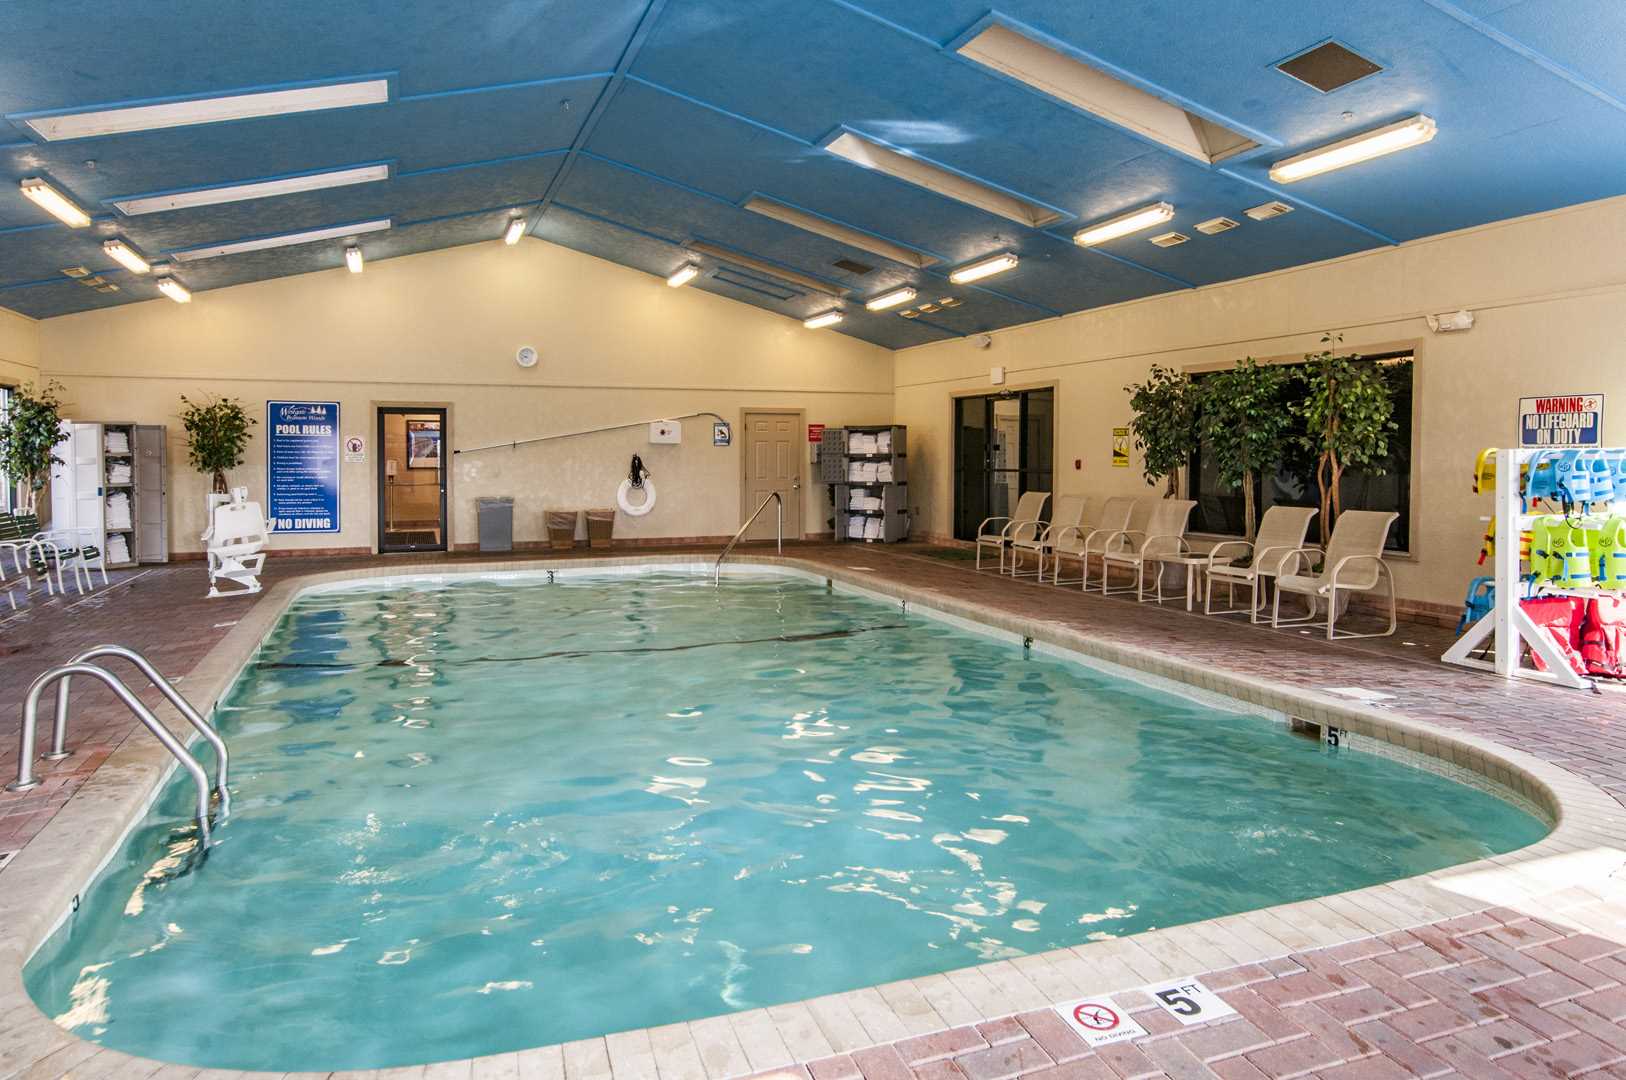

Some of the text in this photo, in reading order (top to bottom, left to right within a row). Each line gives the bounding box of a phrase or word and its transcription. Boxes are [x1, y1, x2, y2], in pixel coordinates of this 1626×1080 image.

[1536, 397, 1584, 413] WARNING
[276, 424, 332, 434] POOL RULES
[1525, 412, 1594, 430] NO LIFEGUARD
[1536, 428, 1581, 444] ON DUTY
[278, 518, 331, 529] NO DIVING
[1327, 725, 1339, 747] 5
[1154, 984, 1202, 1016] 5 FT
